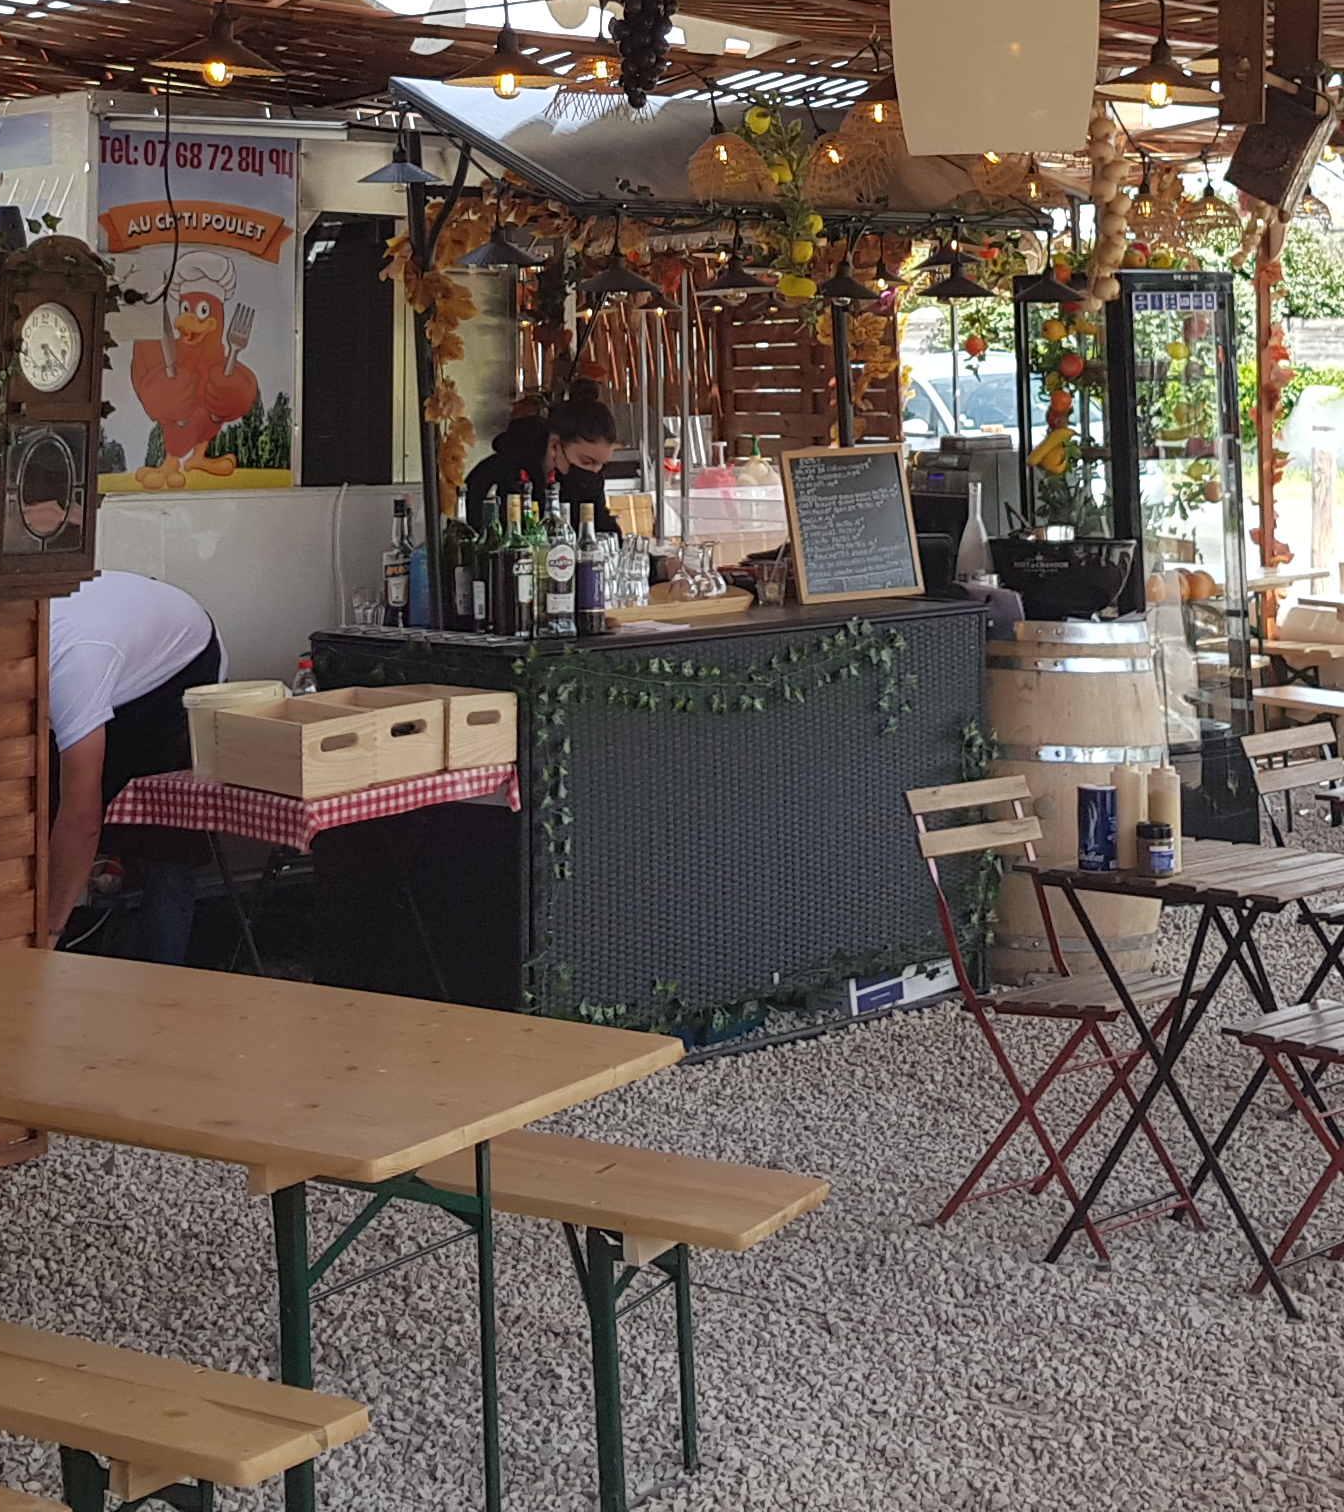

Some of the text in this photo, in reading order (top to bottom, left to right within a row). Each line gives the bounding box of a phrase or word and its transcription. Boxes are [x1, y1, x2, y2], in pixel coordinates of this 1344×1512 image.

[143, 139, 171, 167] 07
[175, 142, 202, 169] 68
[207, 144, 234, 172] 72
[238, 146, 264, 176] 84
[268, 148, 294, 178] 94
[127, 214, 152, 237] AU
[201, 212, 266, 240] POULET
